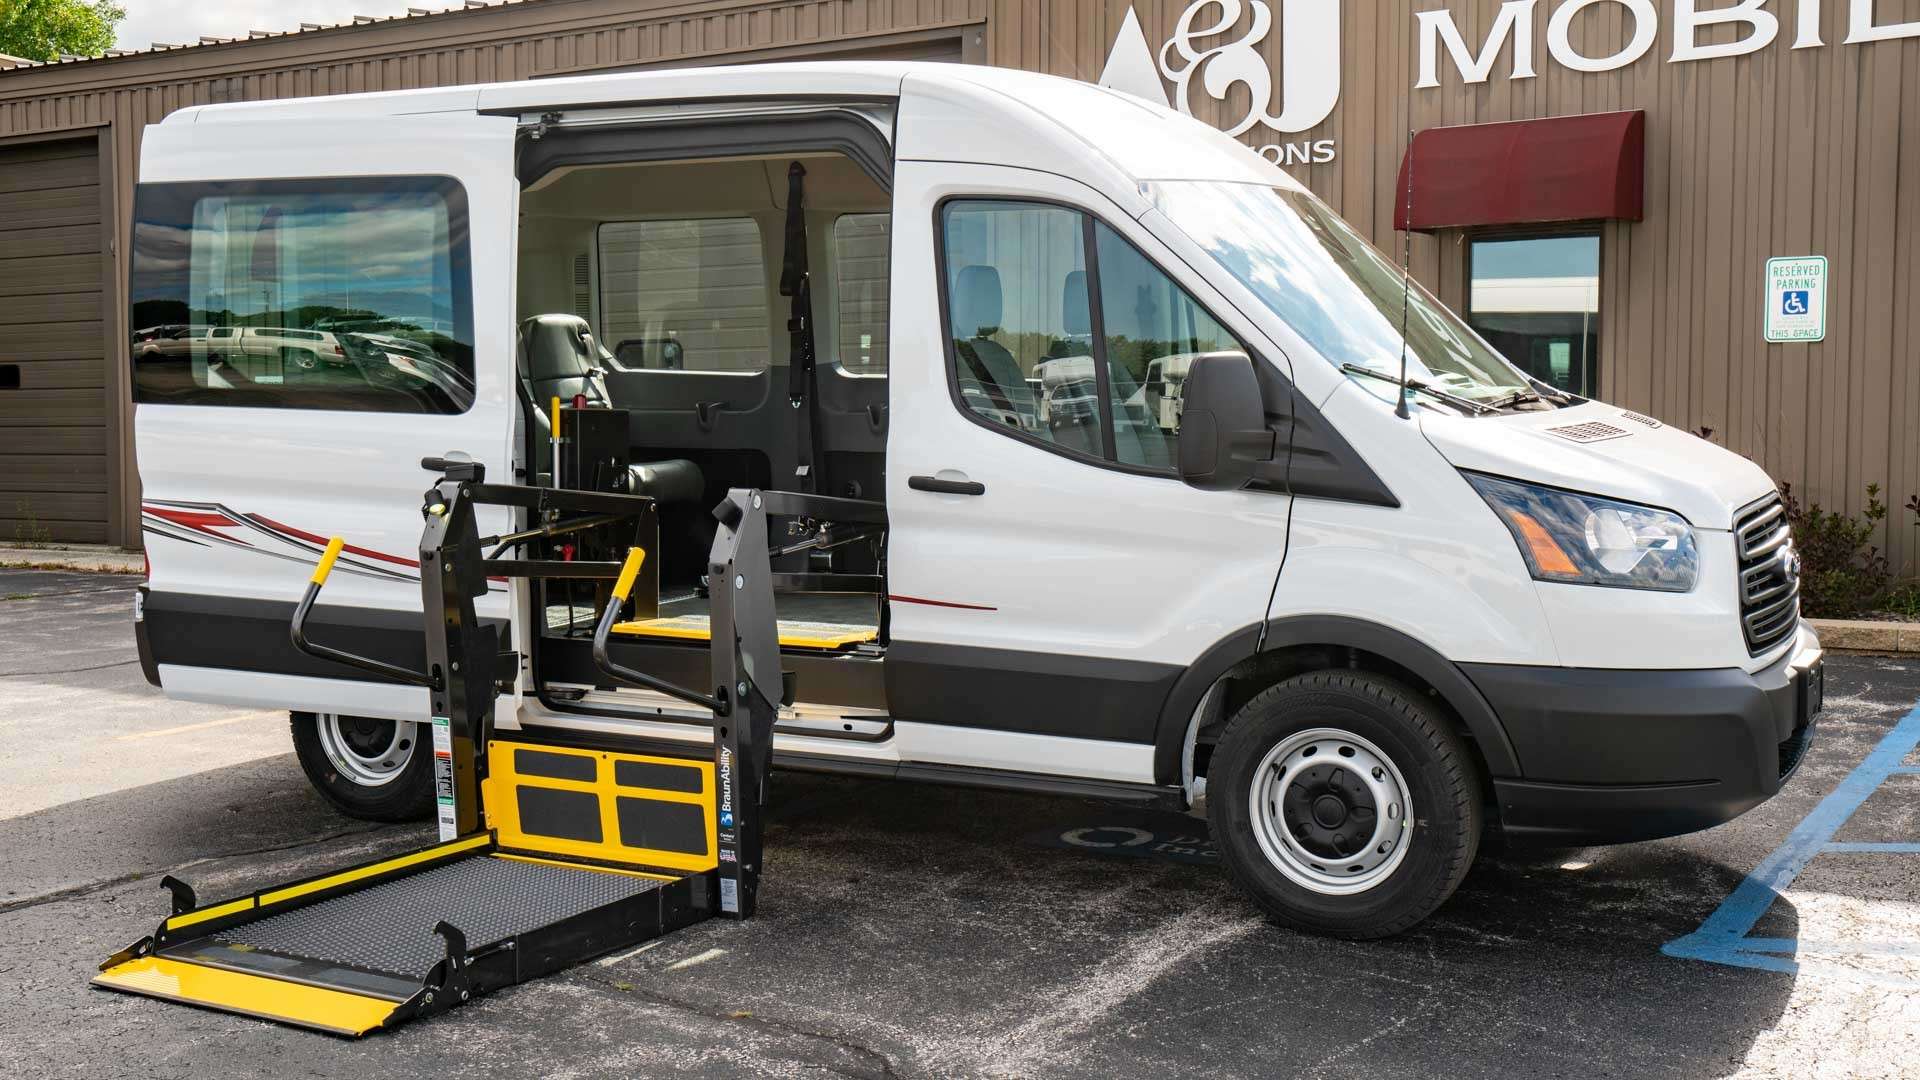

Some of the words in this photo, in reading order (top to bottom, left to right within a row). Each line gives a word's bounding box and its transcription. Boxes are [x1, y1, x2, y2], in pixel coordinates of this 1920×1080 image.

[1248, 139, 1335, 166] ONS
[1773, 265, 1820, 276] RESERVED
[1776, 278, 1816, 289] PARKING
[1771, 329, 1789, 338] THIS
[1793, 328, 1819, 338] SPACE
[720, 747, 732, 812] BraunAbility
